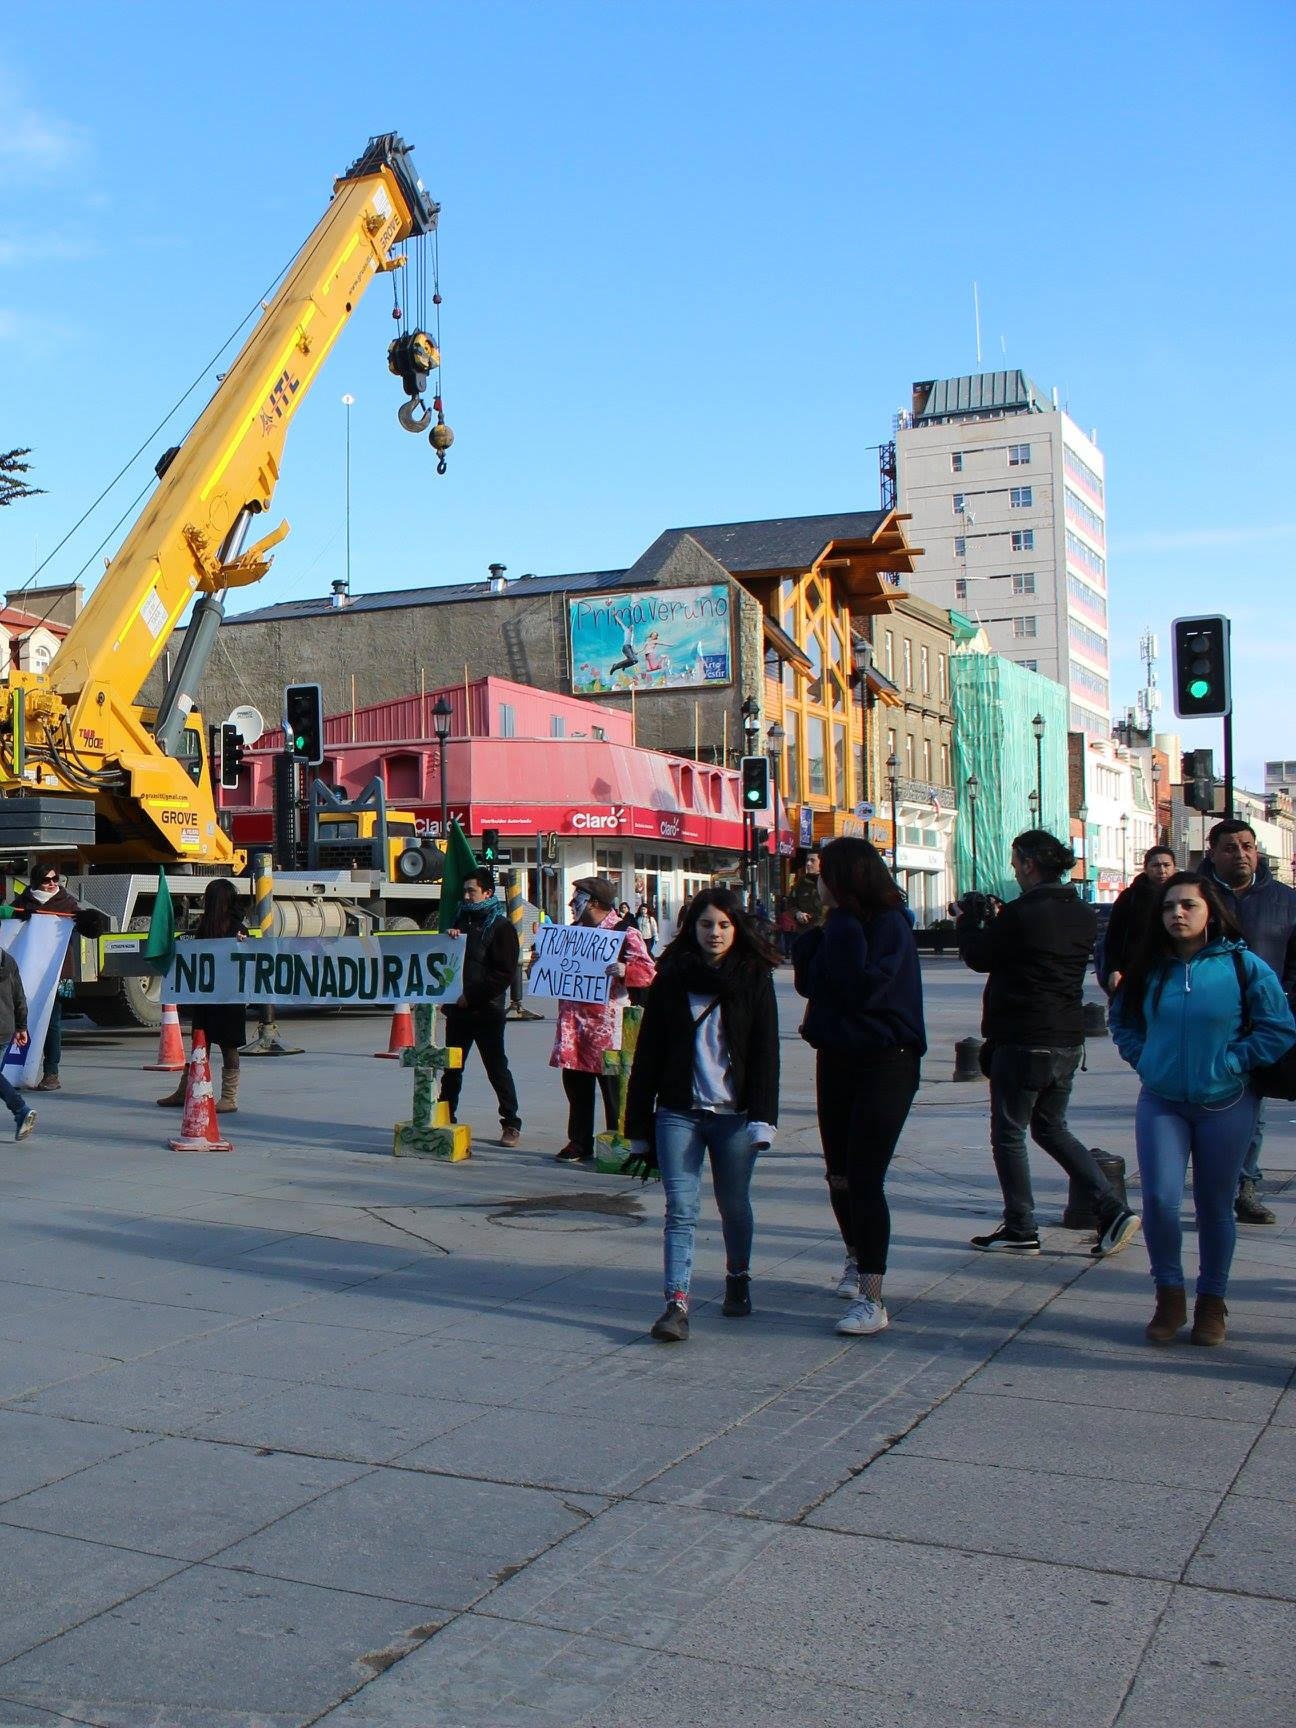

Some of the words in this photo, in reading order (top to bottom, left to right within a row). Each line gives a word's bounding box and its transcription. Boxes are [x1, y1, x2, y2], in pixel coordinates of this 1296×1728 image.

[161, 811, 198, 826] GROVE
[572, 808, 624, 829] Claro
[660, 819, 678, 837] Claro
[538, 927, 619, 962] TRONADURAS
[174, 953, 215, 994] NO
[230, 952, 448, 1000] TRONADURAS
